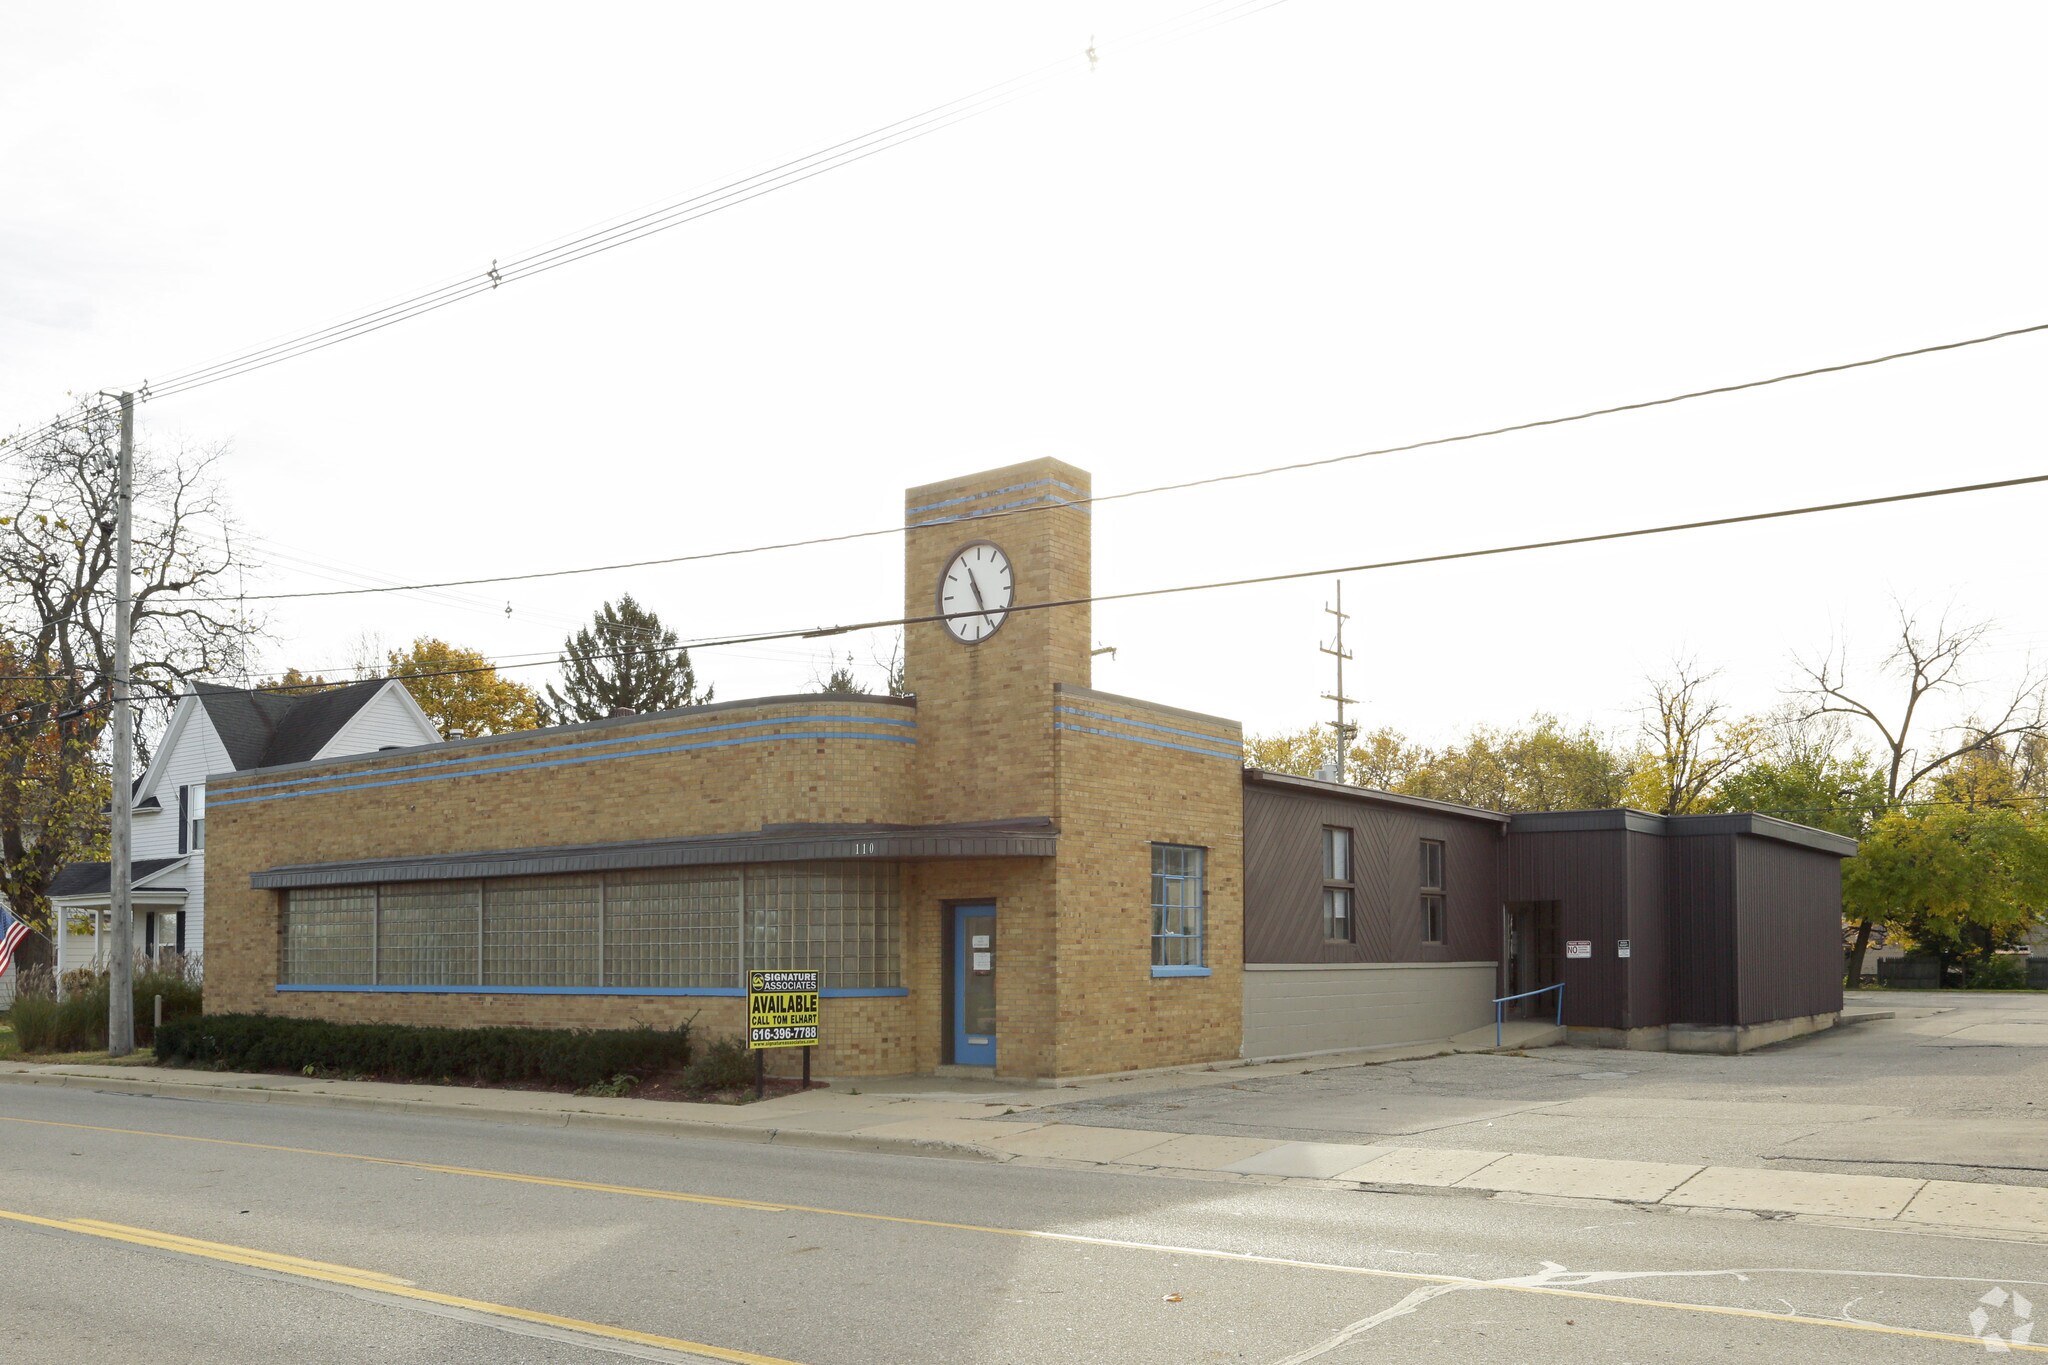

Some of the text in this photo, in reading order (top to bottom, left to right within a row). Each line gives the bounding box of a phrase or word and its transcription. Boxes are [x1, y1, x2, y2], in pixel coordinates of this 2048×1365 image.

[856, 843, 874, 854] 110
[764, 973, 816, 981] SIGNATURE
[764, 981, 816, 990] ASSOCIATES
[752, 995, 817, 1013] AVAILABLE
[752, 1014, 817, 1025] CALL TOM ELHART
[752, 1027, 816, 1040] 616-396-7788
